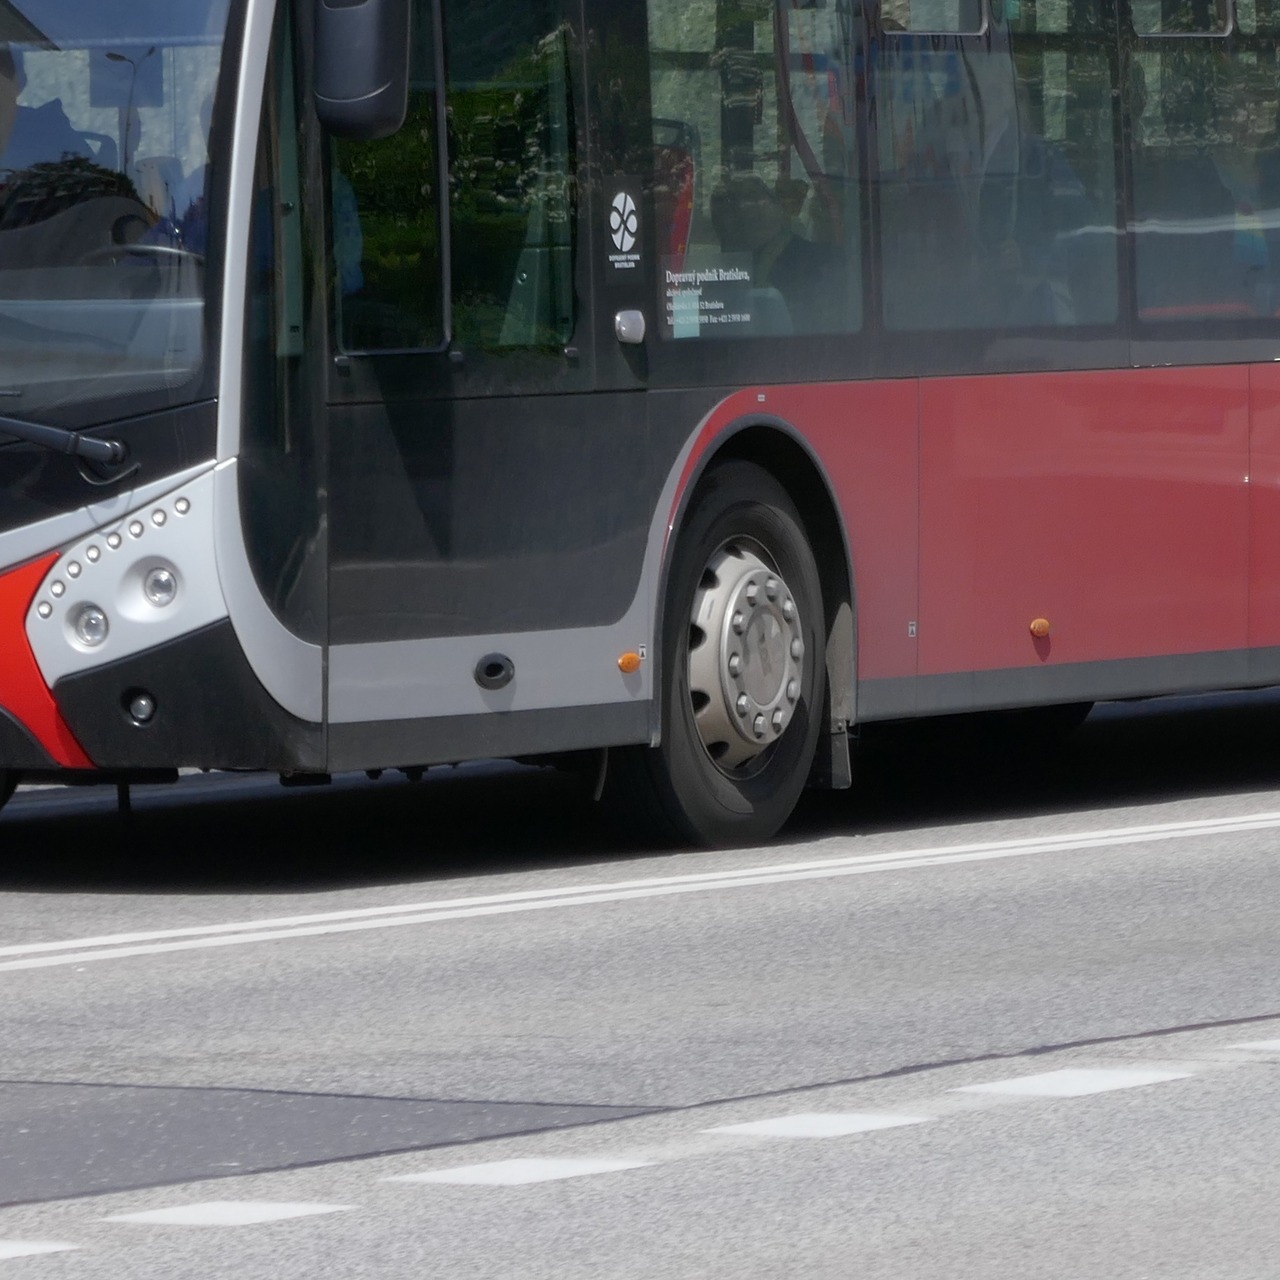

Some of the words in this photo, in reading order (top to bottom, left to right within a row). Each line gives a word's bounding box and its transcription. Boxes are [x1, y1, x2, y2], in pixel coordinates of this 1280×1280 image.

[665, 269, 696, 286] Dopravný
[696, 268, 719, 285] podnik
[719, 267, 750, 281] Bratislava,
